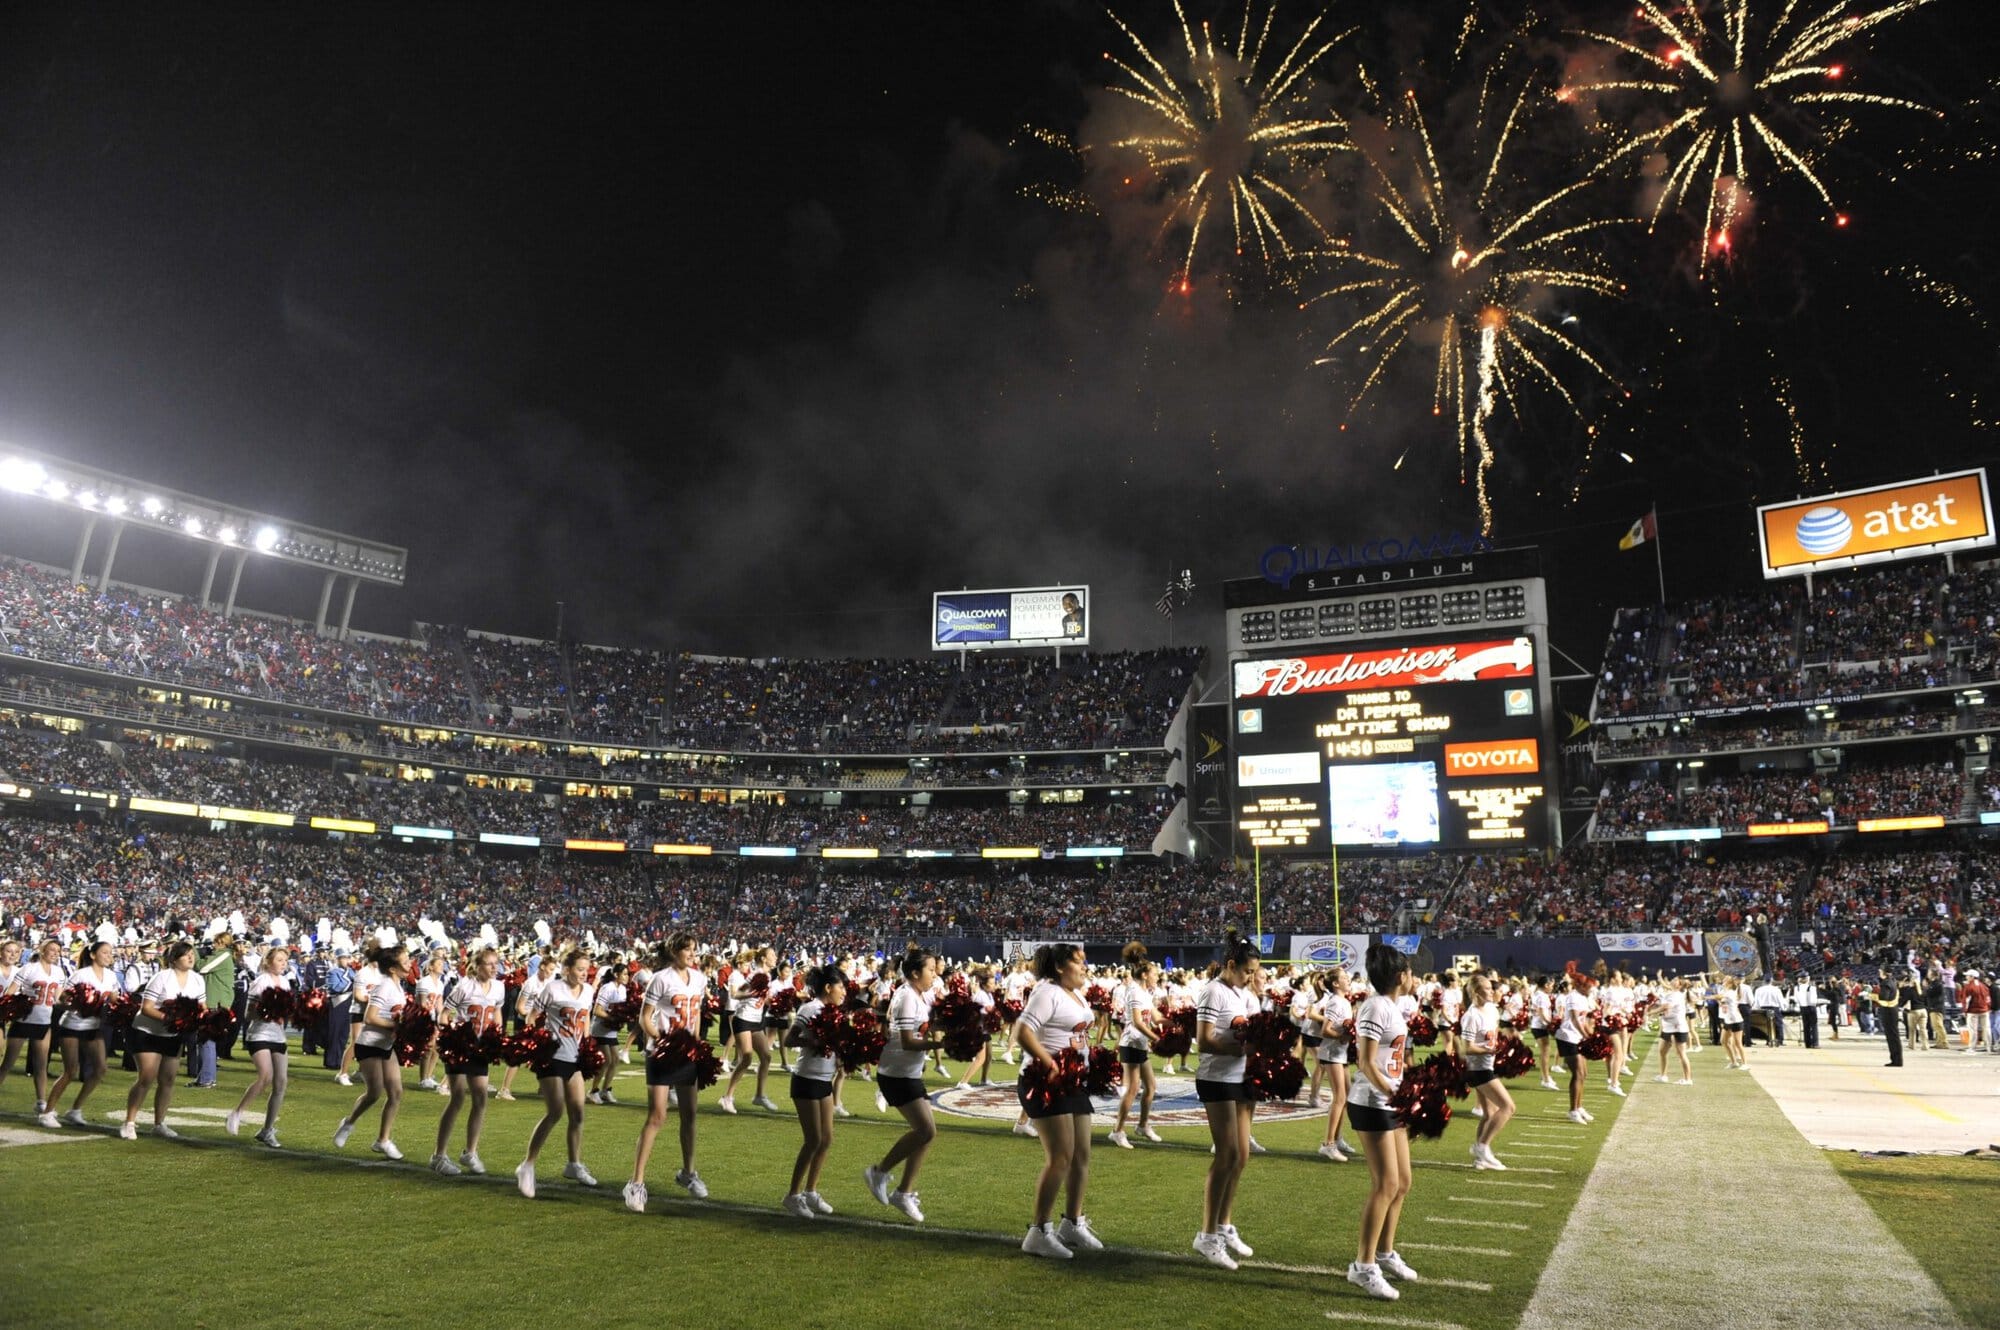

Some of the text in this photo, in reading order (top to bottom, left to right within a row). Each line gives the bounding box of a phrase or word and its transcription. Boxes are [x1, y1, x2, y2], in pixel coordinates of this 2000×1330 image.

[1864, 493, 1958, 538] at&t
[1259, 527, 1495, 590] QUALCOMM
[1308, 562, 1473, 588] STADIUM
[1014, 594, 1061, 604] PALOMAR
[1014, 604, 1061, 612] POMERADO
[940, 609, 1008, 624] QUALCOMM
[1261, 646, 1457, 696] Budweiser
[1346, 690, 1411, 706] THANKS TO
[1337, 703, 1422, 721] DR PEPPER
[1316, 715, 1451, 737] HALFTIME SHOW
[1449, 749, 1534, 769] TOYOTA
[1195, 762, 1225, 775] Sprint
[1309, 940, 1335, 951] PACIFIC
[1671, 935, 1694, 954] N
[1456, 955, 1477, 973] 25
